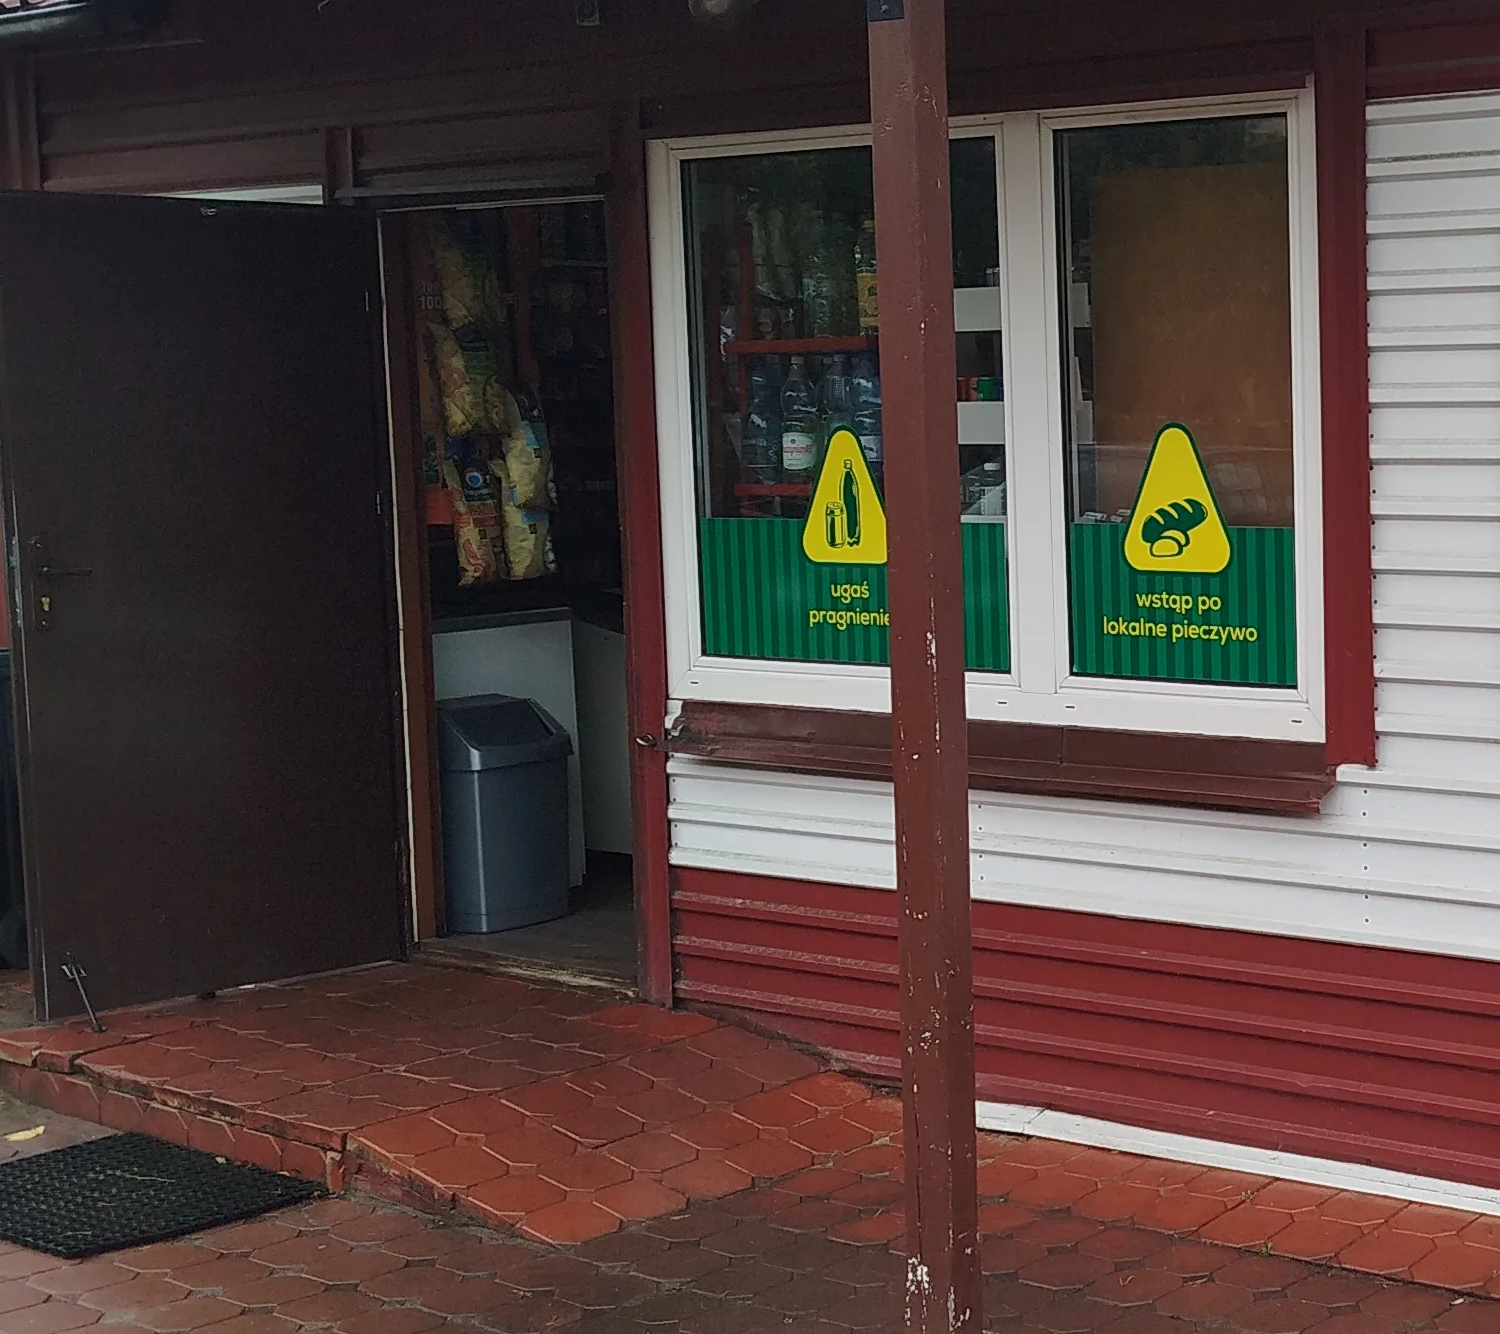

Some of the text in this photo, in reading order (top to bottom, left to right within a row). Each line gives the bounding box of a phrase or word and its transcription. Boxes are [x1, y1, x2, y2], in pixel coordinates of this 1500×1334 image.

[831, 580, 869, 603] ugaś
[1136, 592, 1222, 615] wstąp po
[1103, 616, 1258, 645] lokalne pieczywo
